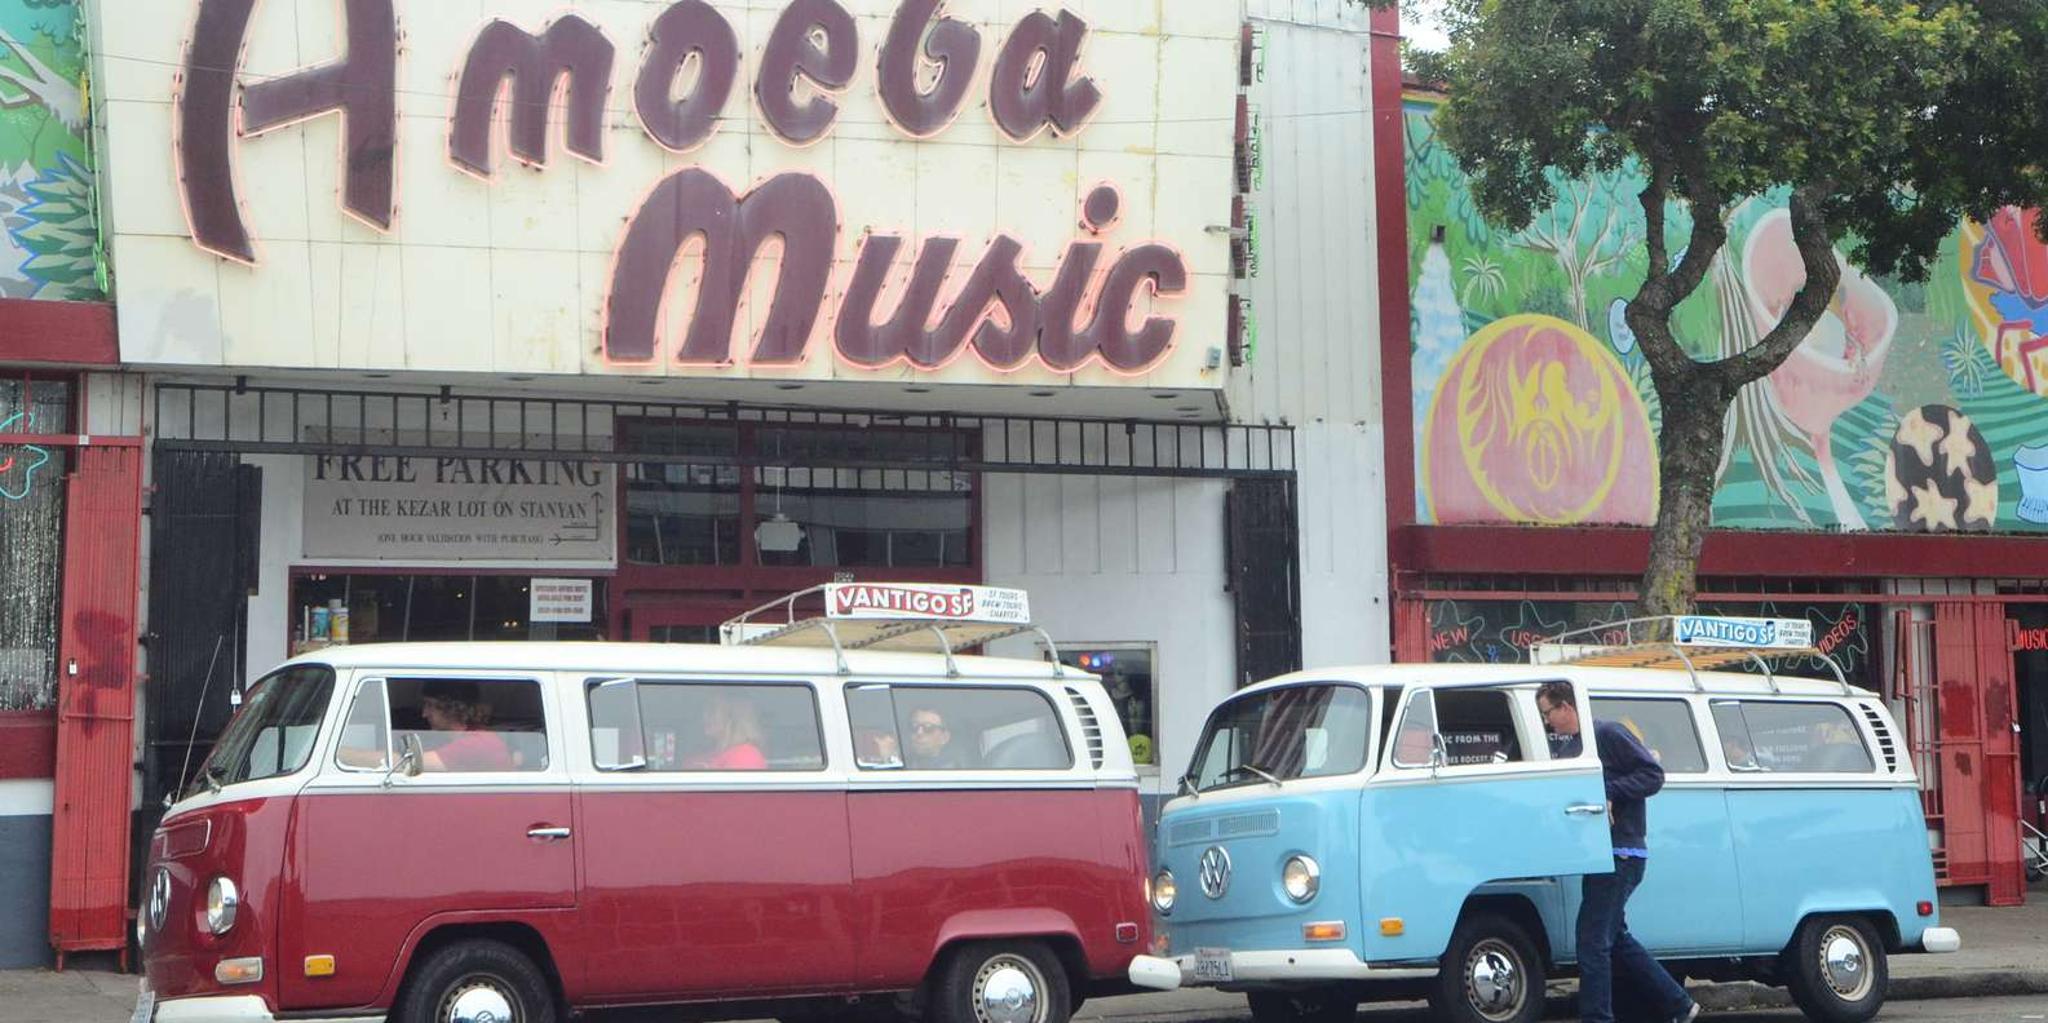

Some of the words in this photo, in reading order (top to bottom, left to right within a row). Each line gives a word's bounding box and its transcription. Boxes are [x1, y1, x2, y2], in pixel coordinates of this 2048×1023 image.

[175, 0, 1103, 265] Amoeba
[604, 166, 1188, 376] Music
[315, 453, 417, 483] FREE
[434, 455, 601, 487] PARKING
[332, 498, 353, 516] AT
[358, 498, 391, 517] THE
[396, 499, 452, 518] KEZAR
[458, 500, 489, 518] LOT
[493, 502, 515, 518] ON
[519, 501, 588, 519] STANYAN
[837, 586, 947, 614] VANTIGO
[951, 592, 973, 615] SF
[1431, 626, 1468, 651] NEW
[1681, 618, 1757, 643] VANTIGO
[1759, 626, 1775, 644] SF
